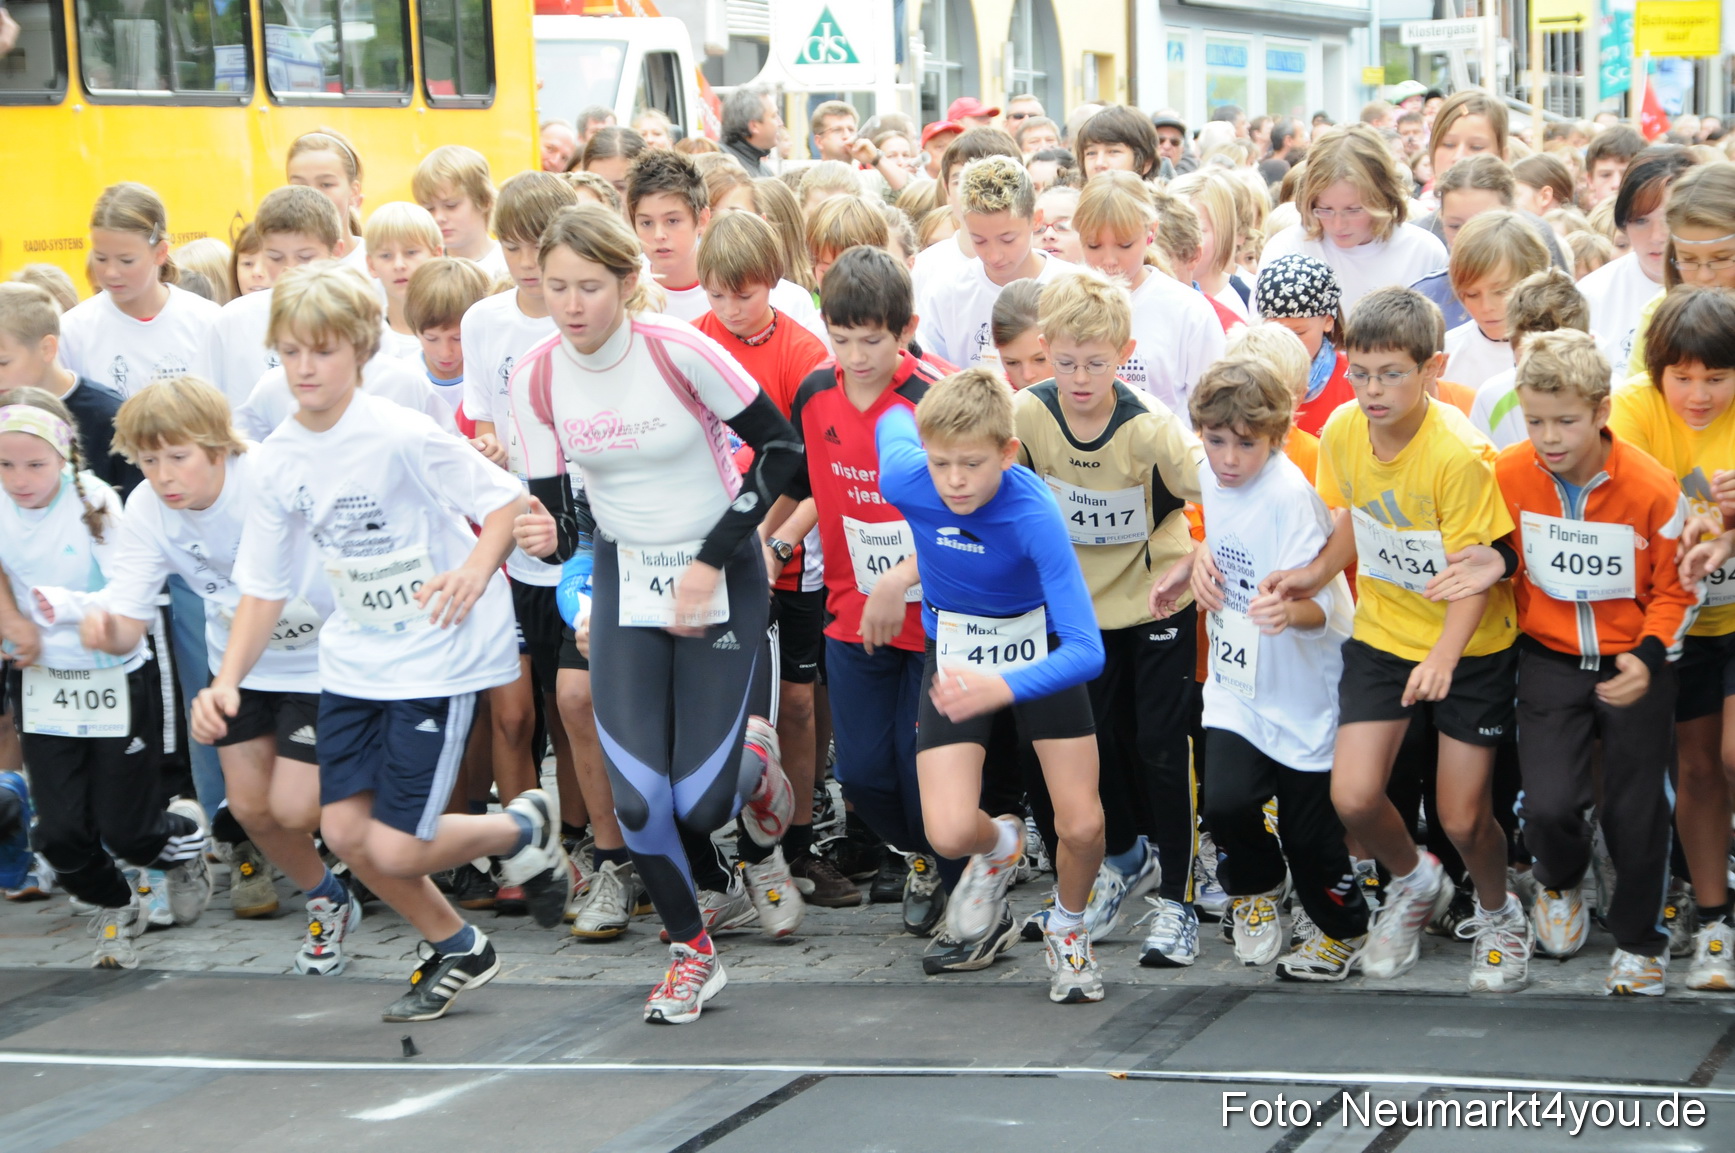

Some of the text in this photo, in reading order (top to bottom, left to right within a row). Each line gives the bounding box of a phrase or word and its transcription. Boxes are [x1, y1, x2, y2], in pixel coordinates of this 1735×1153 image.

[1408, 22, 1478, 39] Klostergasse
[23, 238, 84, 253] RADIO-SYSTEMS
[1069, 457, 1101, 469] JAKO
[1068, 490, 1107, 507] Johan
[1070, 508, 1136, 528] 4117
[858, 528, 902, 547] Samuel
[1106, 531, 1145, 542] PFLEIDERER
[1549, 524, 1598, 545] Florian
[936, 537, 986, 555] skinfit
[641, 550, 693, 567] Isabella
[1378, 548, 1439, 576] 4134
[1550, 551, 1622, 576] 4095
[1217, 557, 1255, 579] 21.09.2008
[966, 622, 998, 636] Maxi
[1149, 633, 1172, 641] JAKO
[941, 642, 948, 655] J
[967, 638, 1036, 665] 4100
[48, 668, 91, 680] Nadine
[27, 684, 34, 697] J
[53, 688, 118, 710] 4106
